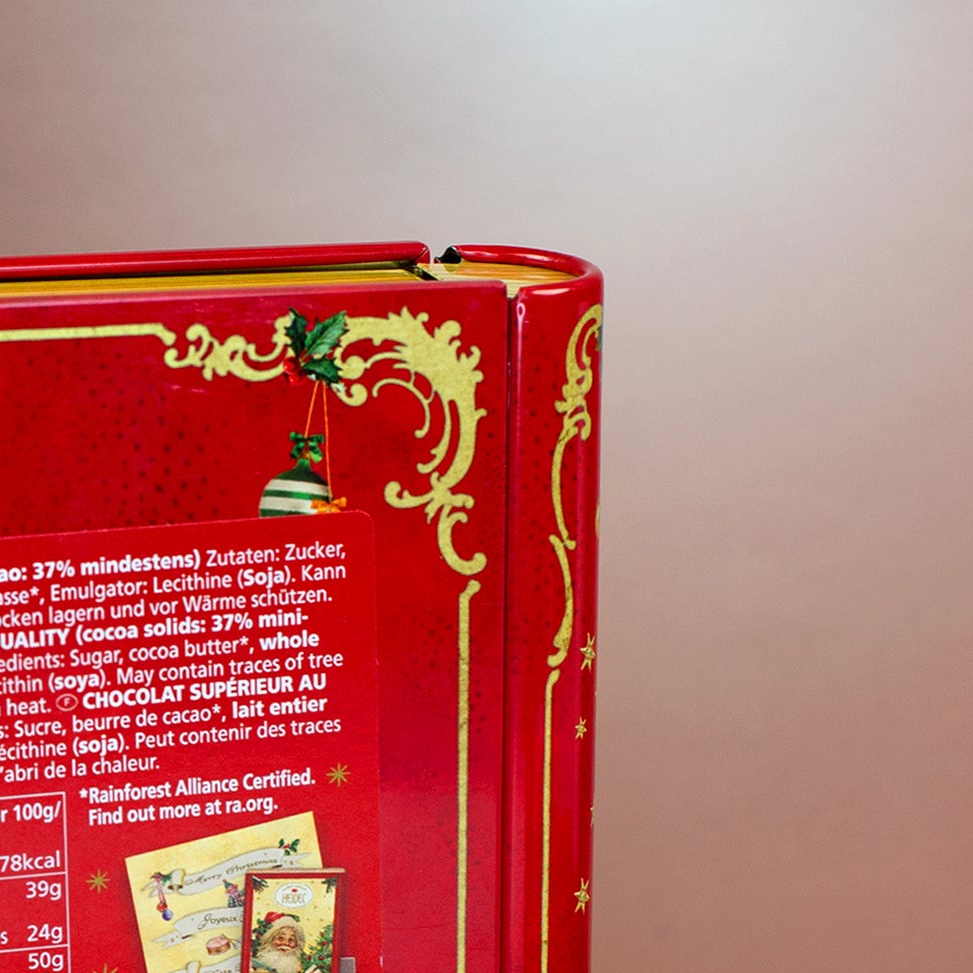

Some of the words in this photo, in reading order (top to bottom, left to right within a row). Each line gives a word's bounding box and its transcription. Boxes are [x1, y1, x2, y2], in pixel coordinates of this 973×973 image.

[32, 559, 75, 580] 37%
[80, 550, 201, 576] mindestens)
[206, 548, 280, 567] Zutaten:
[284, 541, 345, 561] Zucker,
[50, 580, 148, 603] Emulgator:
[152, 571, 232, 593] Lecithine
[237, 565, 296, 590] (Soja).
[301, 564, 346, 581] Kann
[75, 624, 139, 646] (cocoa
[143, 615, 206, 638] solids:
[211, 612, 253, 632] 37%
[258, 607, 308, 628] mini-
[69, 648, 124, 669] Sugar,
[128, 644, 179, 662] cocoa
[258, 629, 320, 651] whole
[6, 697, 51, 716] heat.
[82, 684, 185, 710] CHOCOLAT
[189, 675, 294, 701] SUPÉRIEUR
[298, 672, 326, 691] AU
[14, 719, 66, 738] Sucre,
[71, 714, 131, 733] beurre
[135, 708, 158, 727] de
[232, 699, 265, 719] lait
[269, 695, 328, 716] entier
[174, 777, 239, 796] Alliance
[242, 767, 315, 790] Certified.
[12, 800, 61, 823] 100g/
[88, 805, 123, 826] Find
[126, 804, 155, 822] out
[159, 803, 201, 820] more
[204, 799, 222, 816] at
[225, 797, 278, 815] ra.org.
[25, 880, 61, 901] 39g
[27, 923, 63, 944] 24g
[28, 951, 64, 971] 50g
